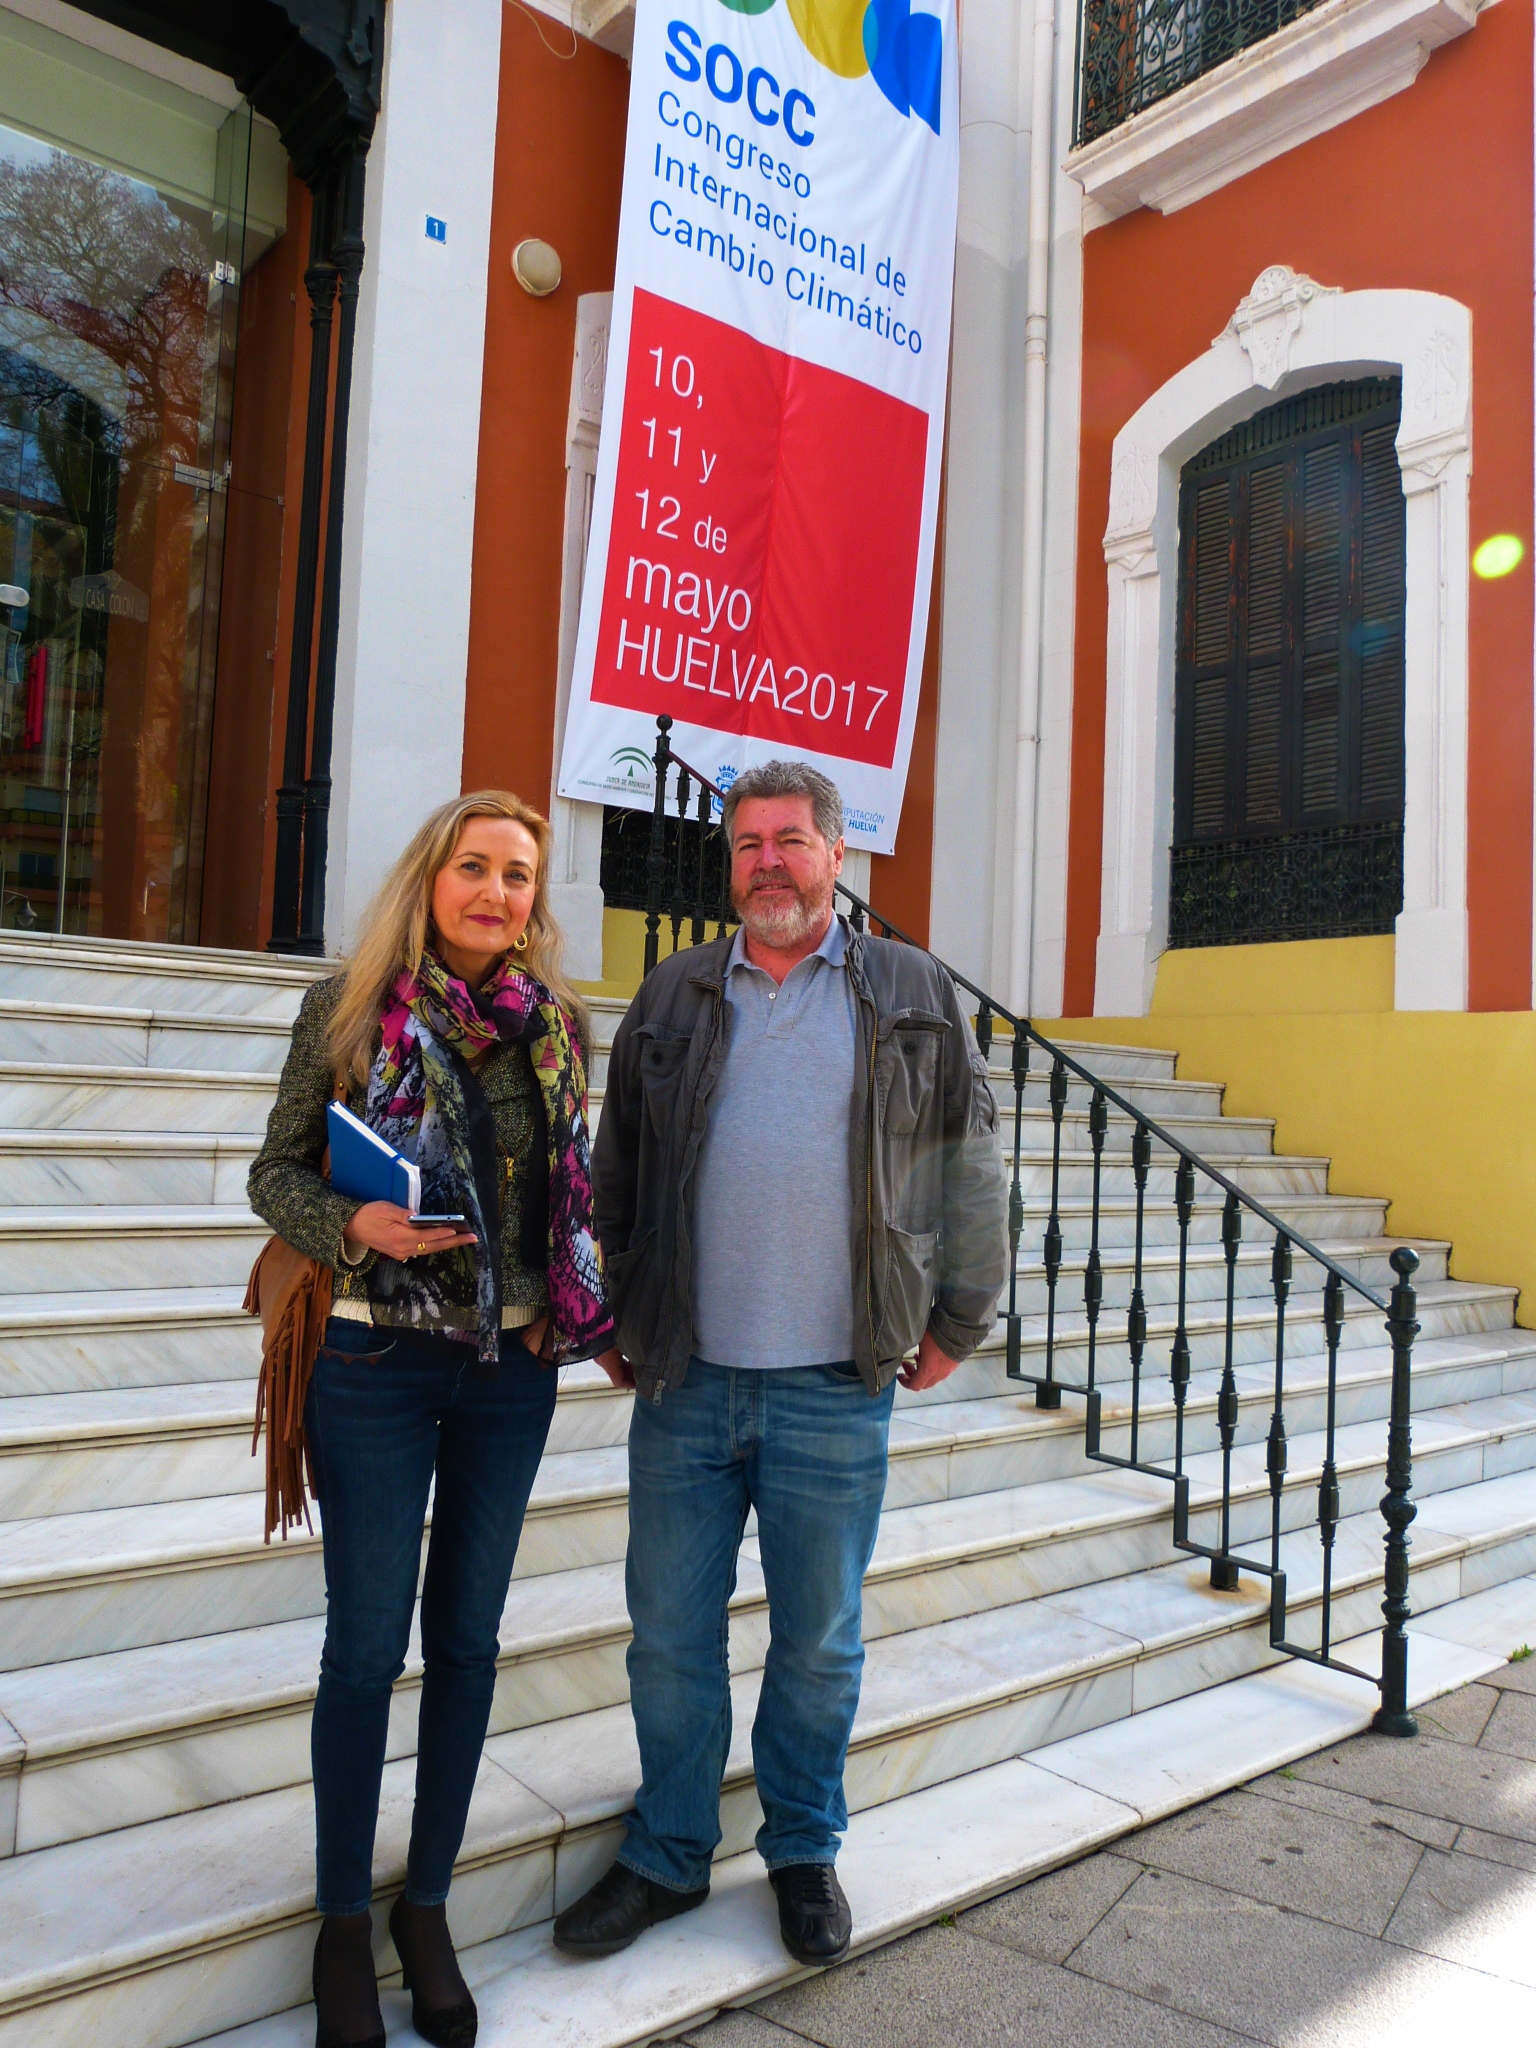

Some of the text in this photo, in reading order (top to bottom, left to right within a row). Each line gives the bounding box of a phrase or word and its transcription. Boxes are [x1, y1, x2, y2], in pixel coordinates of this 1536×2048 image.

[665, 20, 816, 147] SOCC
[658, 90, 812, 199] Congreso
[433, 221, 439, 237] 1
[654, 143, 906, 297] Internacional de
[649, 200, 922, 355] Cambio Climático
[649, 346, 703, 409] 10,
[642, 417, 717, 483] 11 y
[635, 488, 728, 554] 12 de
[86, 588, 105, 612] CASA
[625, 555, 752, 633] mayo
[615, 618, 889, 731] HUELVA2017
[848, 819, 877, 833] HUELVA
